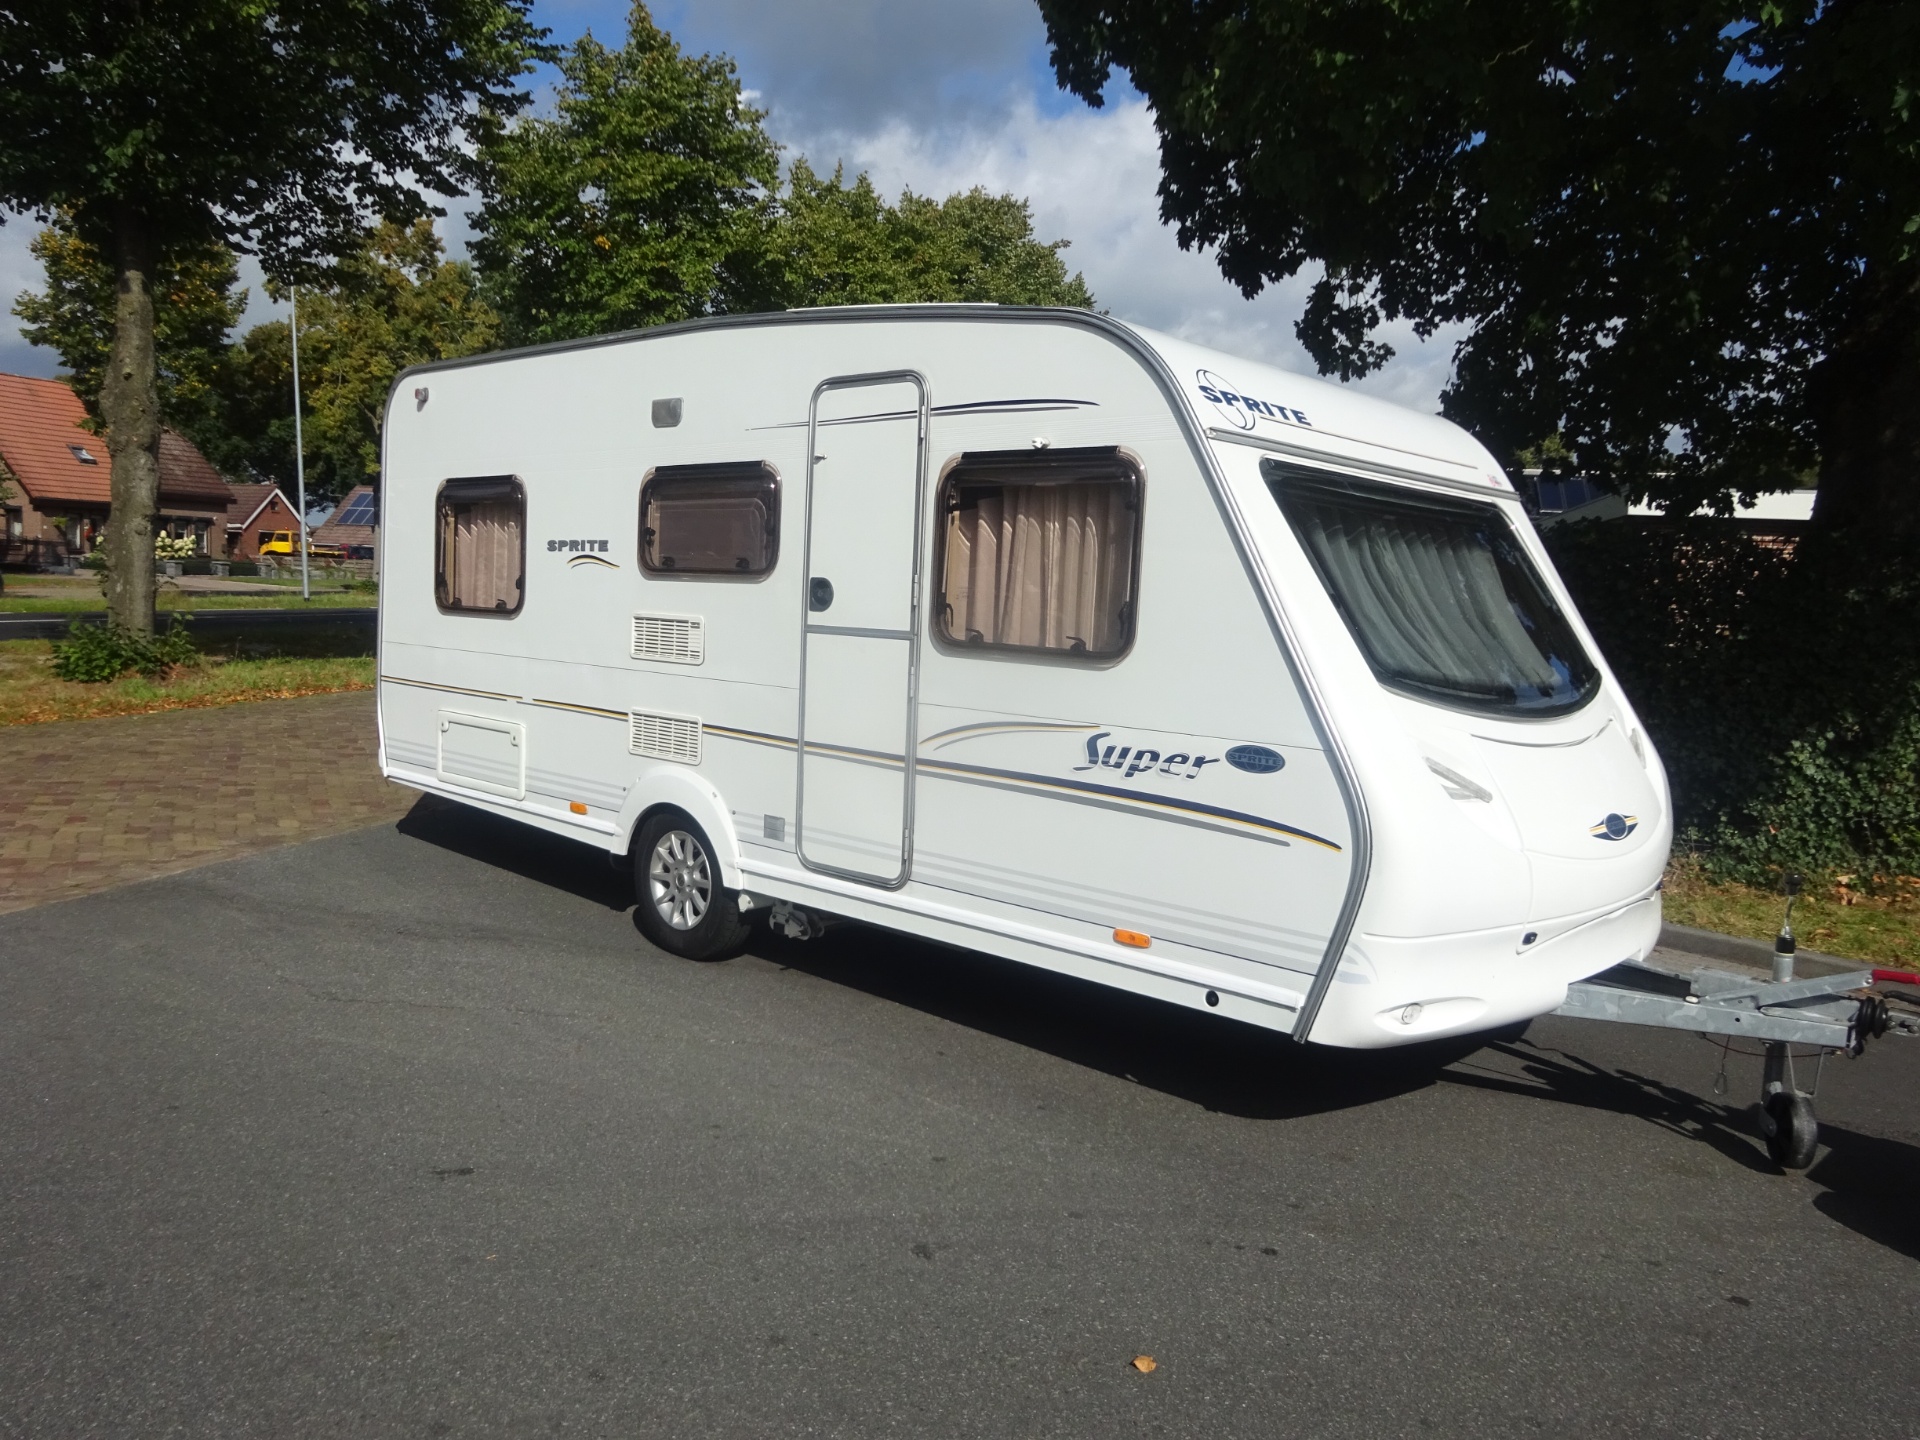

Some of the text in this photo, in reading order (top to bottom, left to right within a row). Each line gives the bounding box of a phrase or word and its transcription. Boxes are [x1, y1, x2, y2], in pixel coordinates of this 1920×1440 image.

[1198, 385, 1312, 426] SPRITE
[547, 540, 608, 552] SPRITE
[1072, 731, 1220, 779] Super
[1228, 752, 1281, 766] SPRITE
